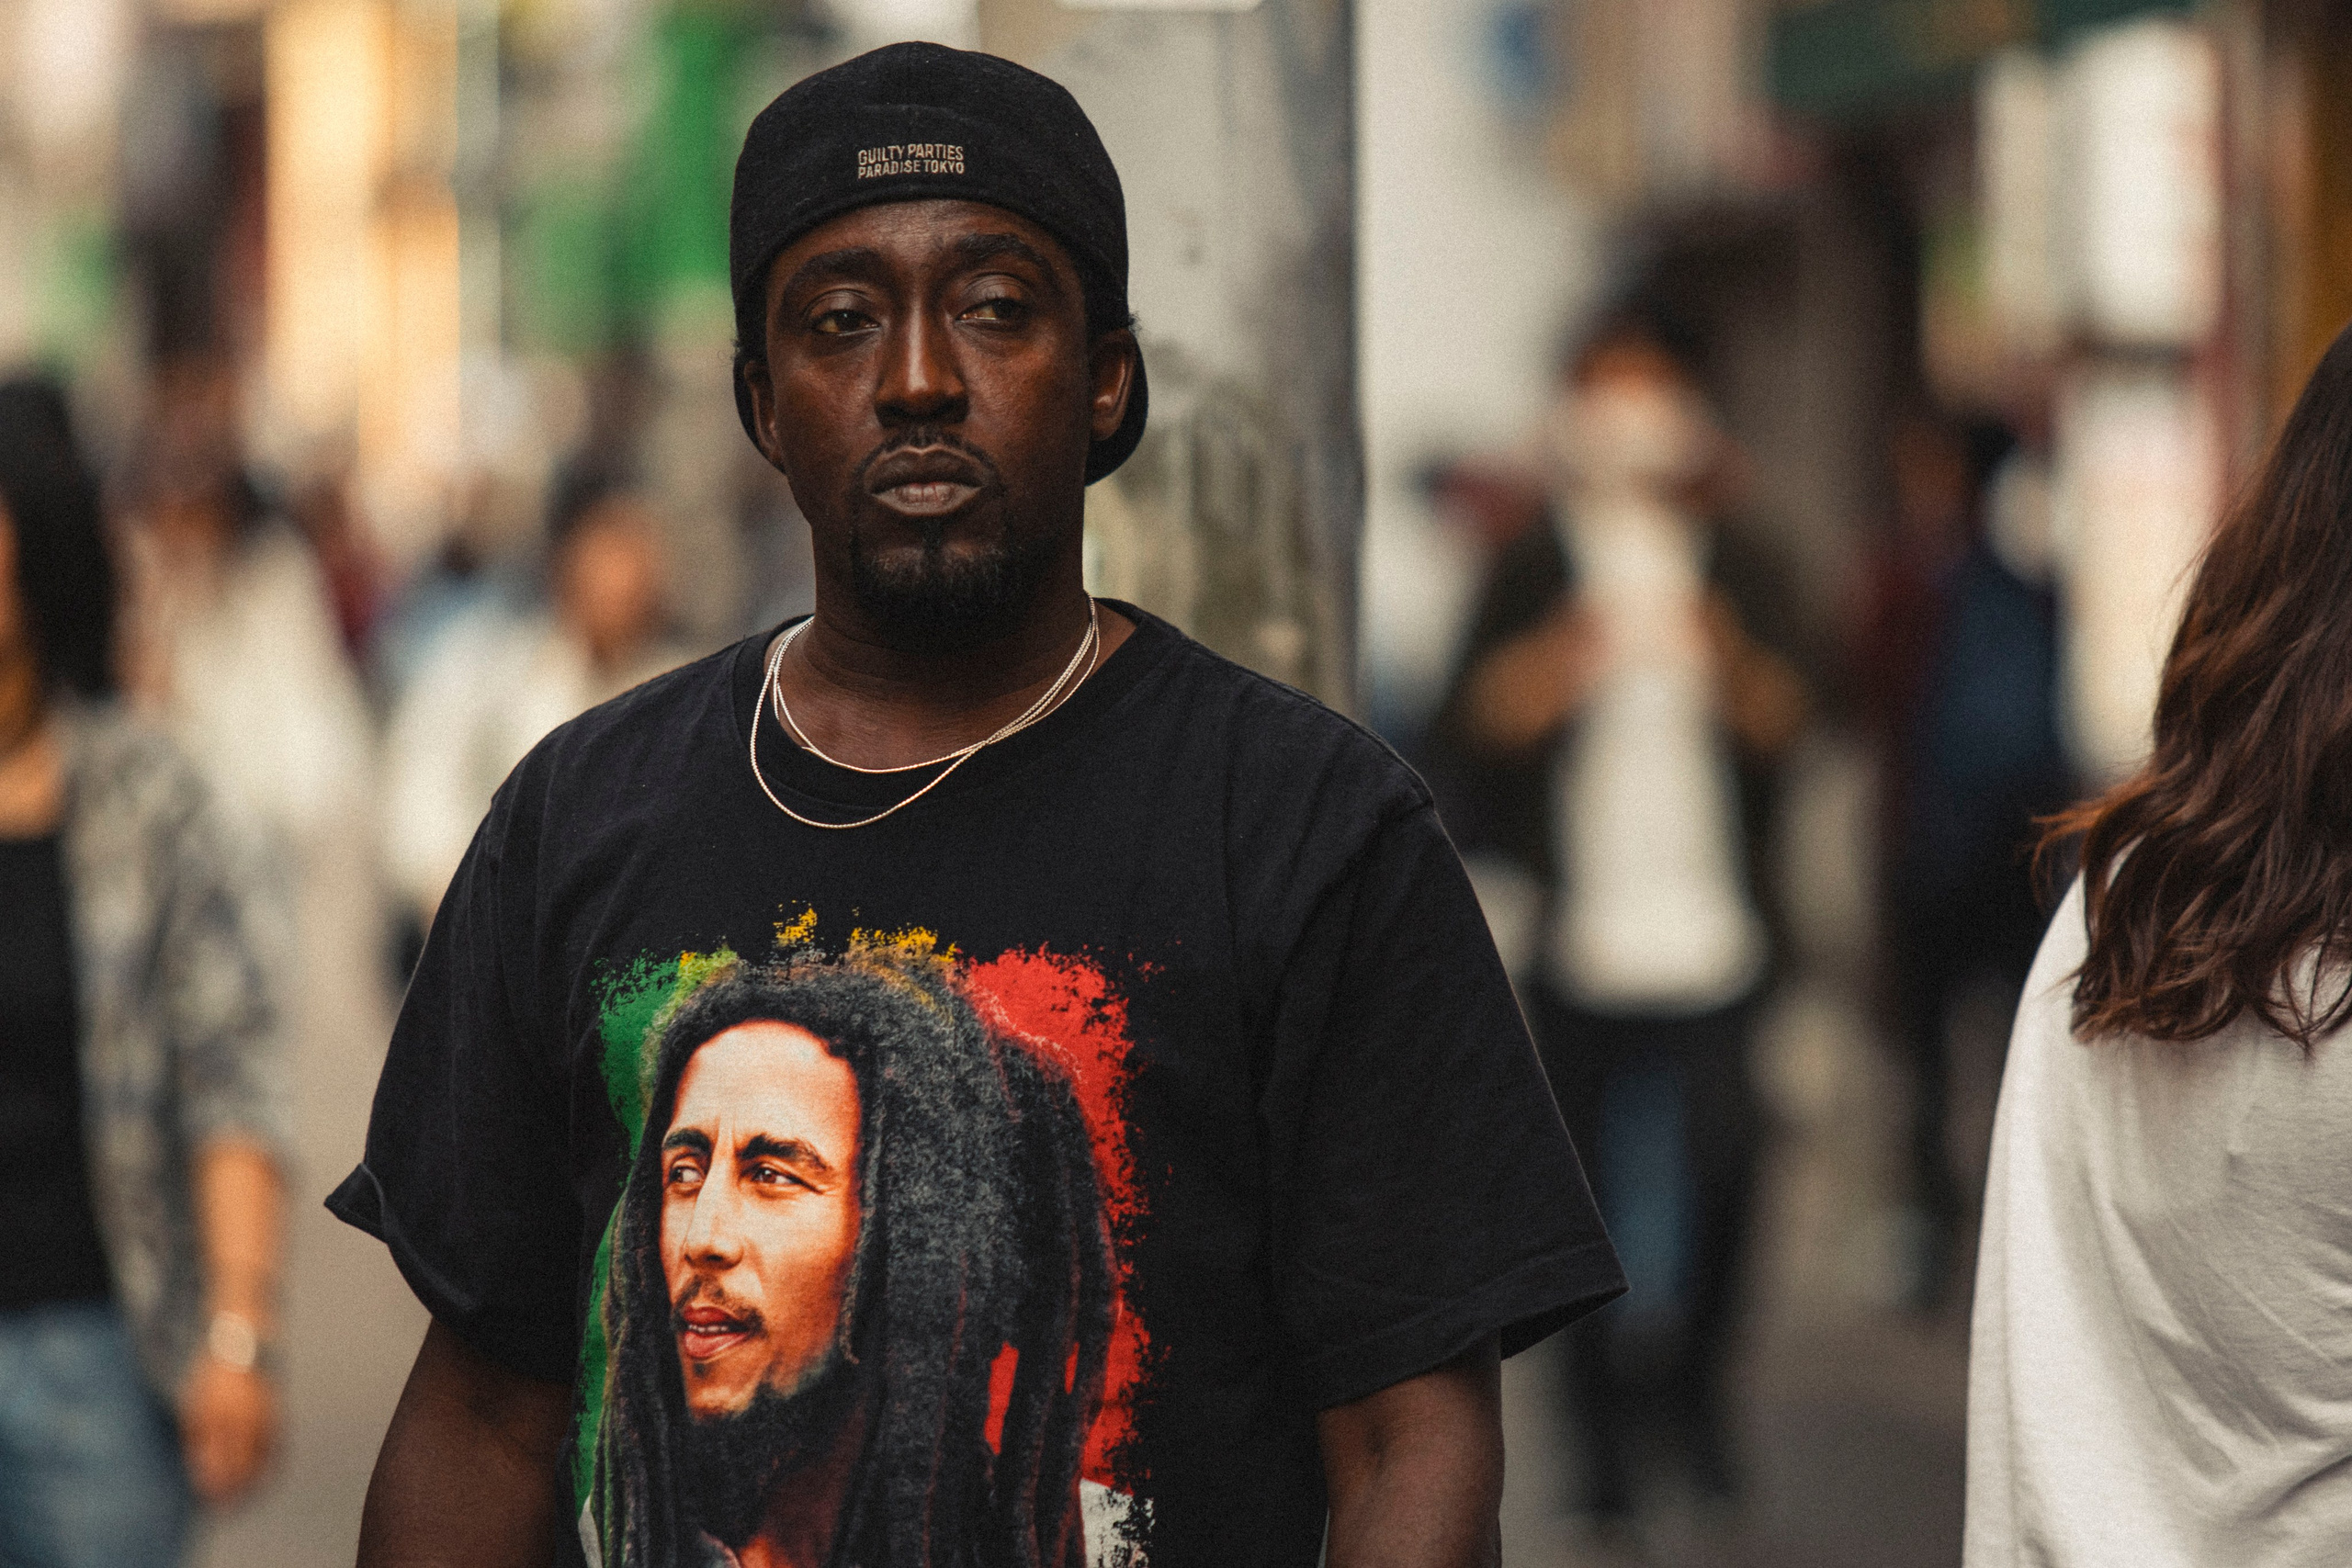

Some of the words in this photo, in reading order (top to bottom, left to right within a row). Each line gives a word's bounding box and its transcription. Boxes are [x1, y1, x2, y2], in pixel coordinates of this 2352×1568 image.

[858, 145, 905, 165] GUILTY
[908, 143, 964, 161] PARTIES
[857, 160, 921, 179] PARADISE
[923, 159, 965, 174] TOKYO
